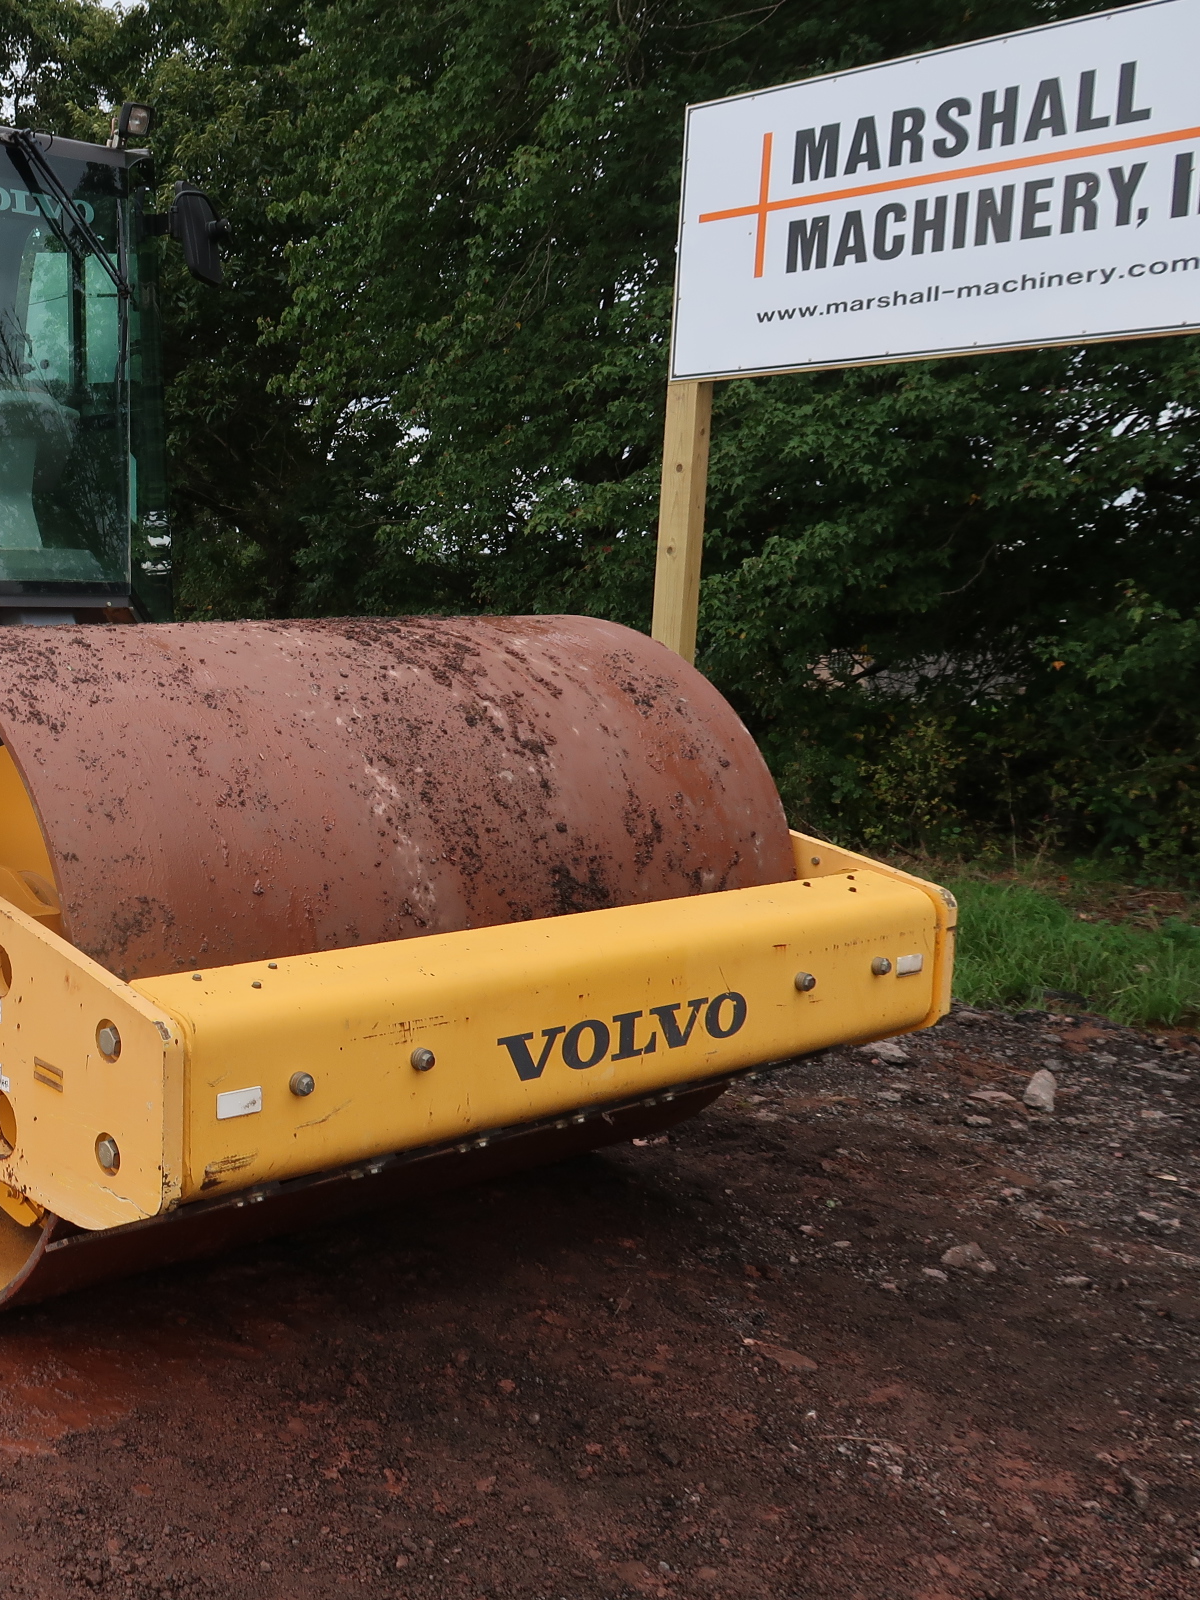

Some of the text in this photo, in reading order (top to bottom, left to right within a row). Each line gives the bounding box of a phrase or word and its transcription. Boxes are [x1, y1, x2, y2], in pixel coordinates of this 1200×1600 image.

[792, 61, 1152, 185] MARSHALL
[785, 162, 1149, 273] MACHINERY,
[756, 256, 1200, 324] www.marshall-machinery.com
[497, 991, 747, 1082] VOLVO
